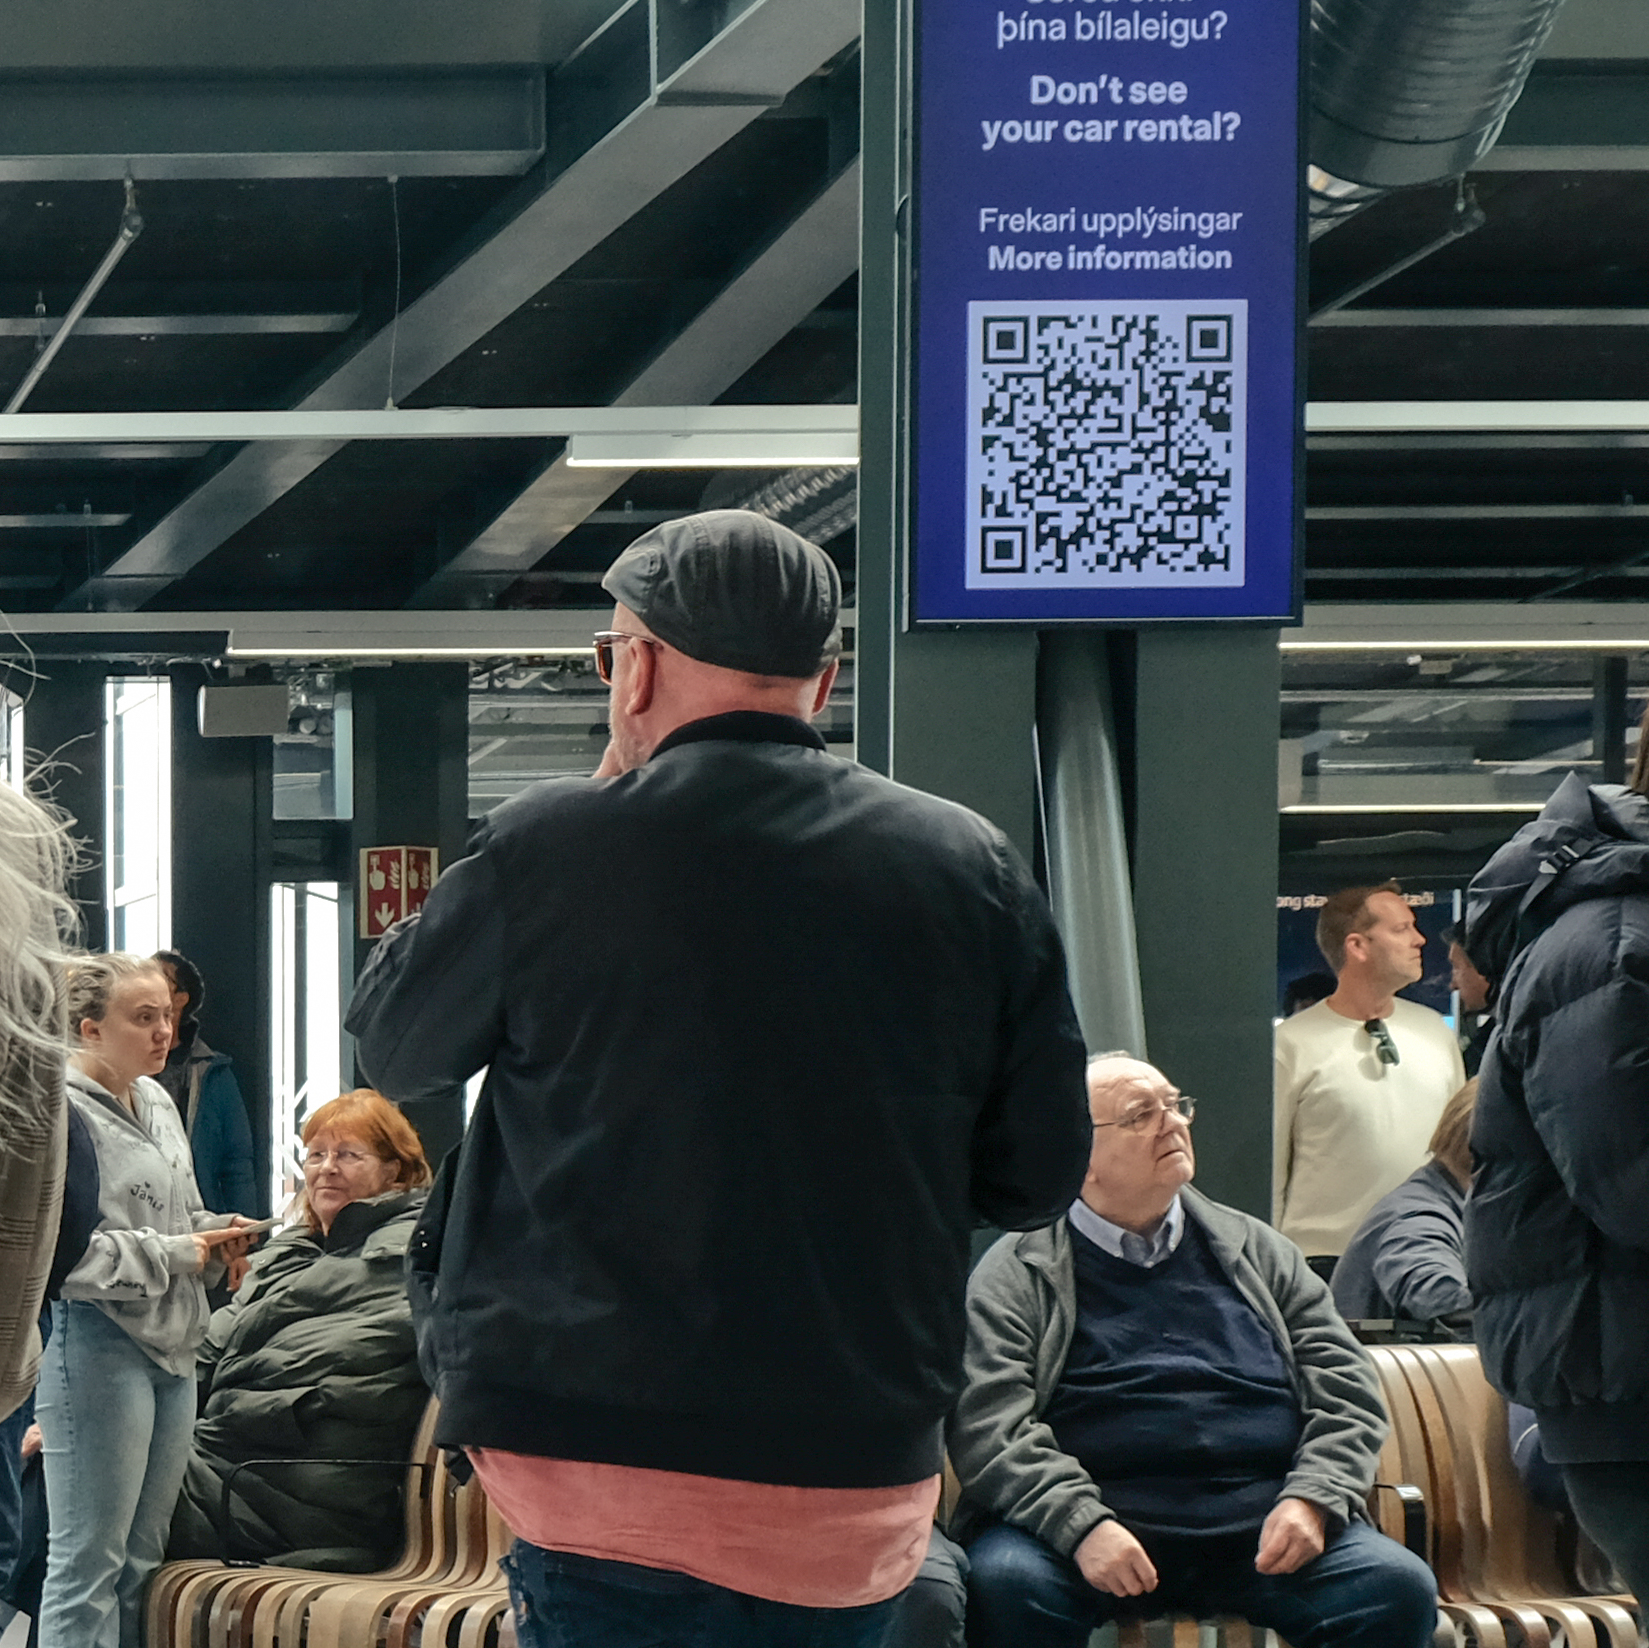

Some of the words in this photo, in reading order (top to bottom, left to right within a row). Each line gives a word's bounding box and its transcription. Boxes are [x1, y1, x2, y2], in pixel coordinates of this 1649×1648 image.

[997, 10, 1067, 50] þína
[1074, 10, 1229, 49] bílaleigu?
[1030, 74, 1124, 105] Don't
[1128, 80, 1188, 105] see
[981, 119, 1059, 151] your
[1063, 119, 1119, 143] car
[1123, 111, 1242, 142] rental?
[979, 206, 1077, 233] Frekari
[1081, 205, 1244, 239] upplýsingar
[988, 245, 1064, 270] More
[1067, 244, 1233, 270] information
